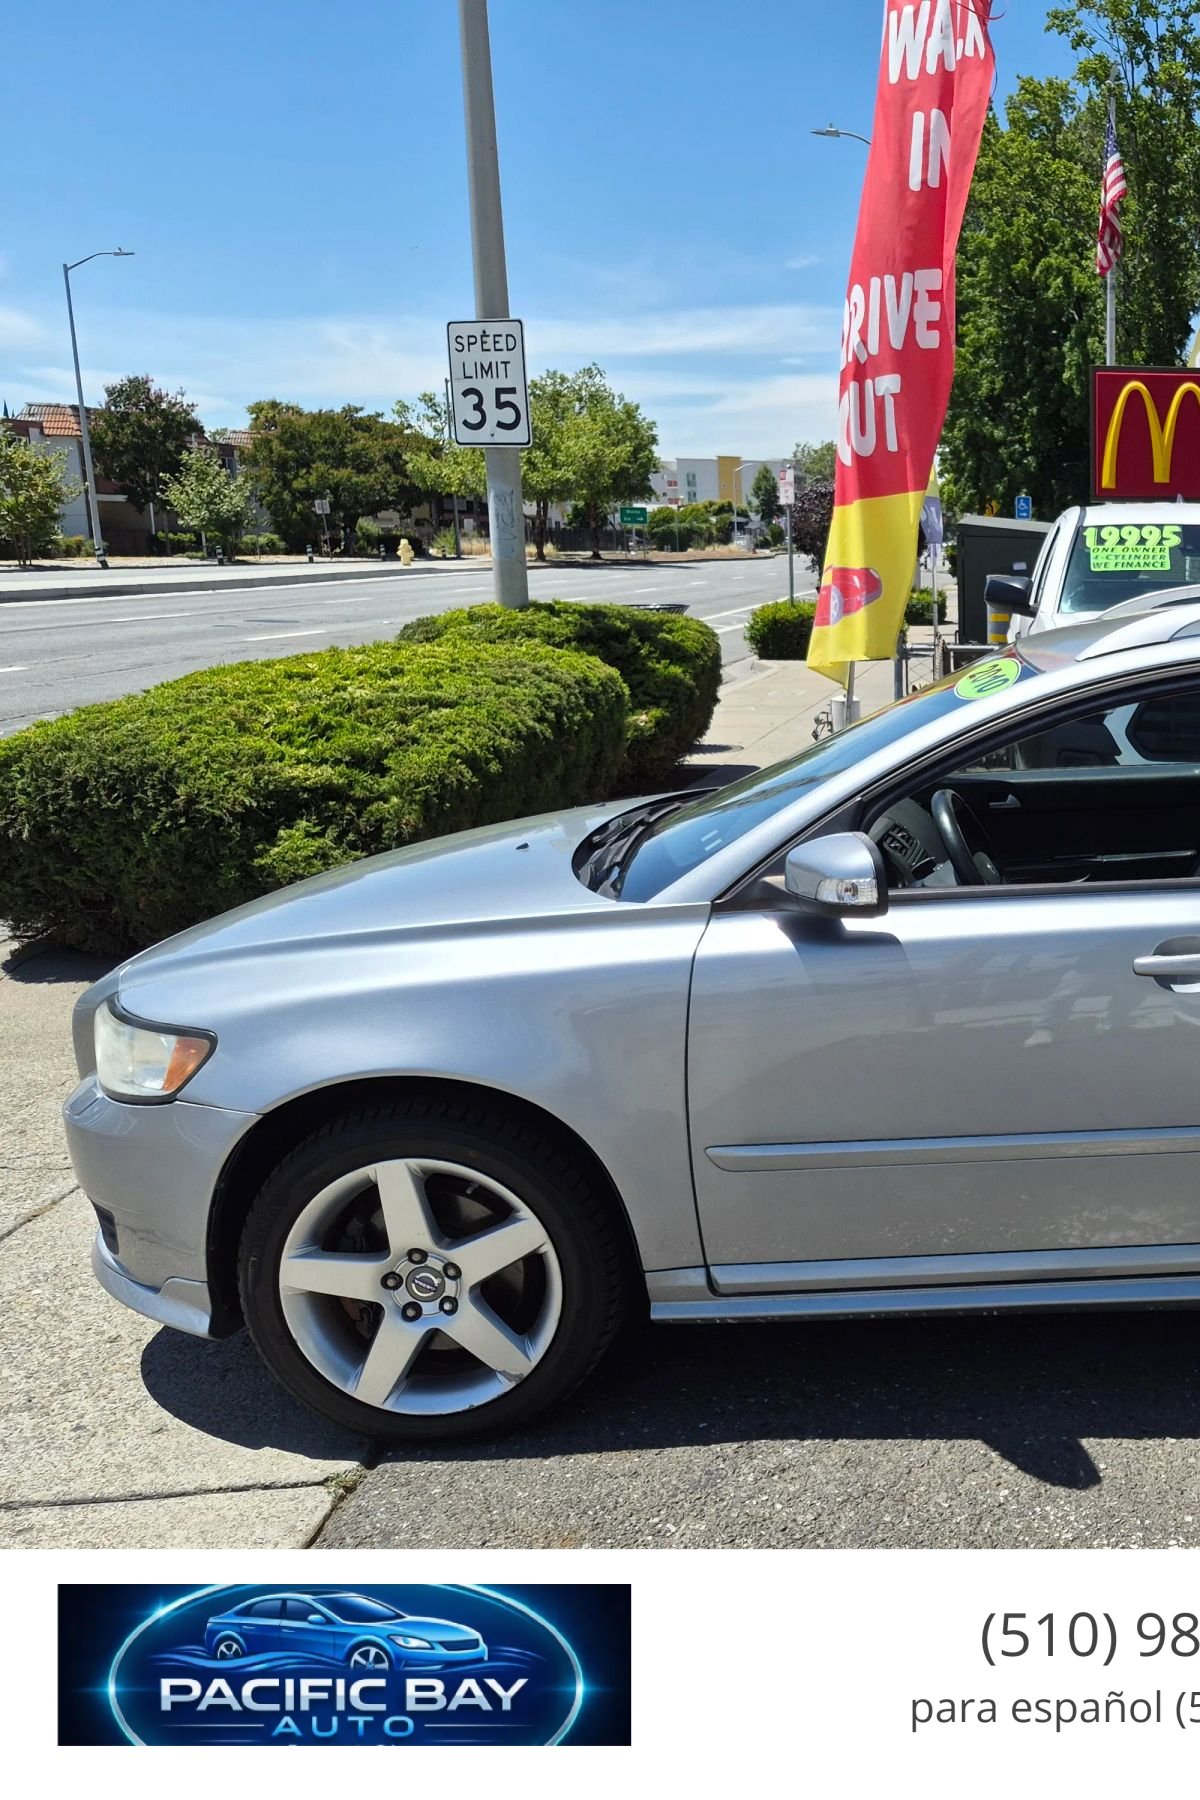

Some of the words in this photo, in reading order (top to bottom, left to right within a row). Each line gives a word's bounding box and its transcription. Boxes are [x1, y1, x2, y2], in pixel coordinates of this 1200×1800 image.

[454, 333, 517, 352] SPEED
[462, 361, 511, 380] LIMIT
[461, 387, 522, 431] 35
[1082, 525, 1183, 548] 19995
[1114, 561, 1167, 569] FINANCE
[968, 663, 1010, 693] 2010
